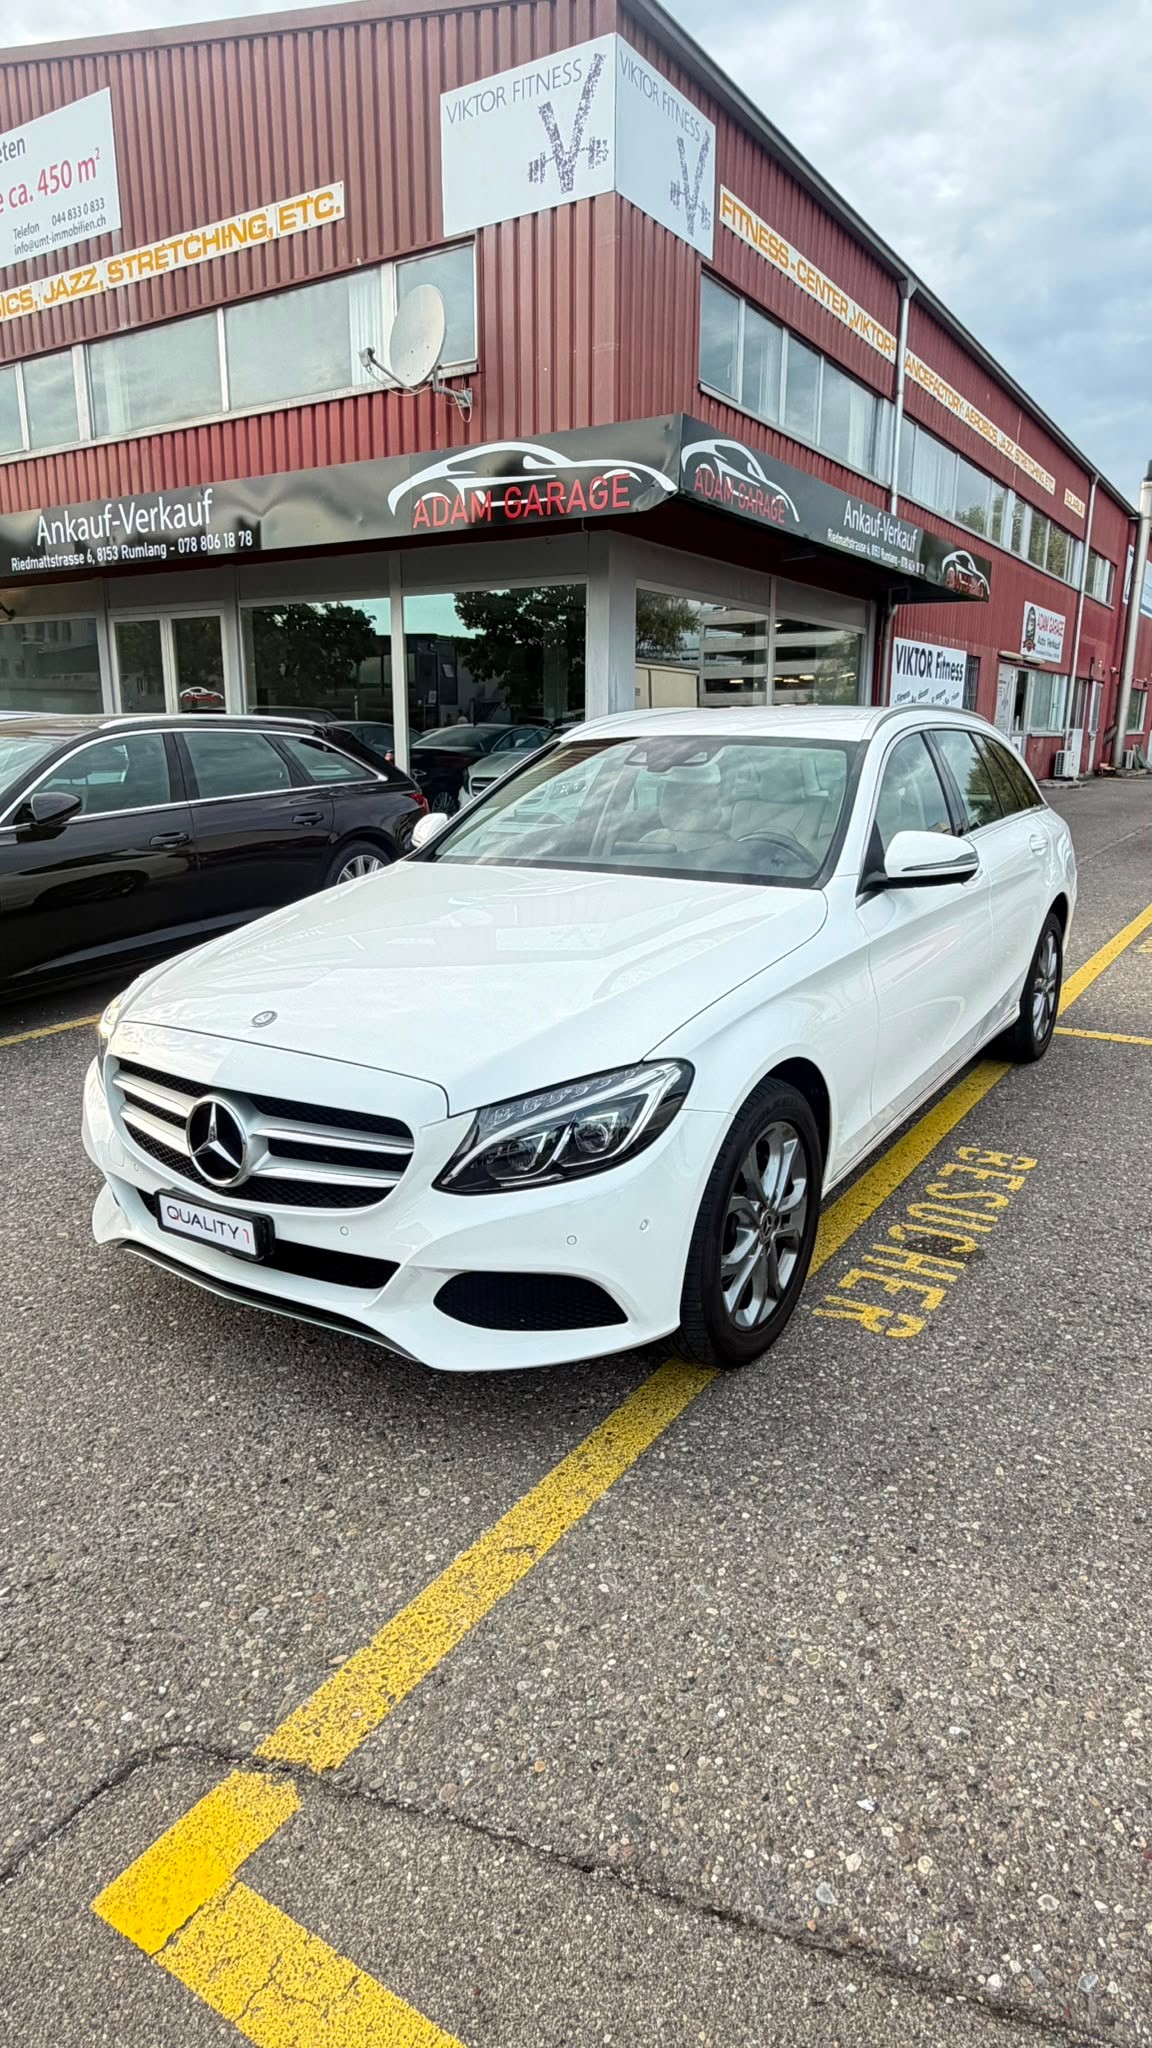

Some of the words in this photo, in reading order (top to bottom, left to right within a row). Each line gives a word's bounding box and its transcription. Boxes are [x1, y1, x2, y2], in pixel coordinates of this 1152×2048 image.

[446, 86, 507, 124] VIKTOR
[513, 58, 583, 102] FITNESS
[620, 50, 658, 106] VIKTOR
[662, 90, 701, 141] FITNESS
[9, 184, 33, 208] ca.
[38, 160, 72, 196] 450
[13, 222, 40, 240] Telefon
[52, 212, 66, 226] 044
[68, 207, 82, 221] 833
[90, 198, 105, 213] 833
[0, 288, 38, 317] ICS,
[43, 265, 105, 304] JAZZ,
[107, 214, 274, 284] STRETCHING,
[278, 191, 341, 231] ETC.
[904, 354, 964, 415] ANCEFACTORY:
[37, 489, 213, 546] Ankauf-Verkauf
[413, 489, 492, 528] ADAM
[505, 473, 631, 520] GARAGE
[694, 468, 734, 506] ADAM
[738, 483, 785, 525] GARAGE
[11, 553, 85, 571] Riedmattstrasse
[87, 551, 95, 565] 6,
[97, 546, 118, 562] 8153
[121, 543, 167, 559] Rumlang
[178, 538, 196, 554] 078
[200, 534, 221, 551] 806
[223, 532, 235, 548] 18
[238, 530, 253, 547] 78
[843, 500, 918, 554] Ankauf-Verkauf
[896, 643, 933, 678] VIKTOR
[935, 651, 964, 682] Fitness
[811, 1146, 1038, 1338] BESUCHER
